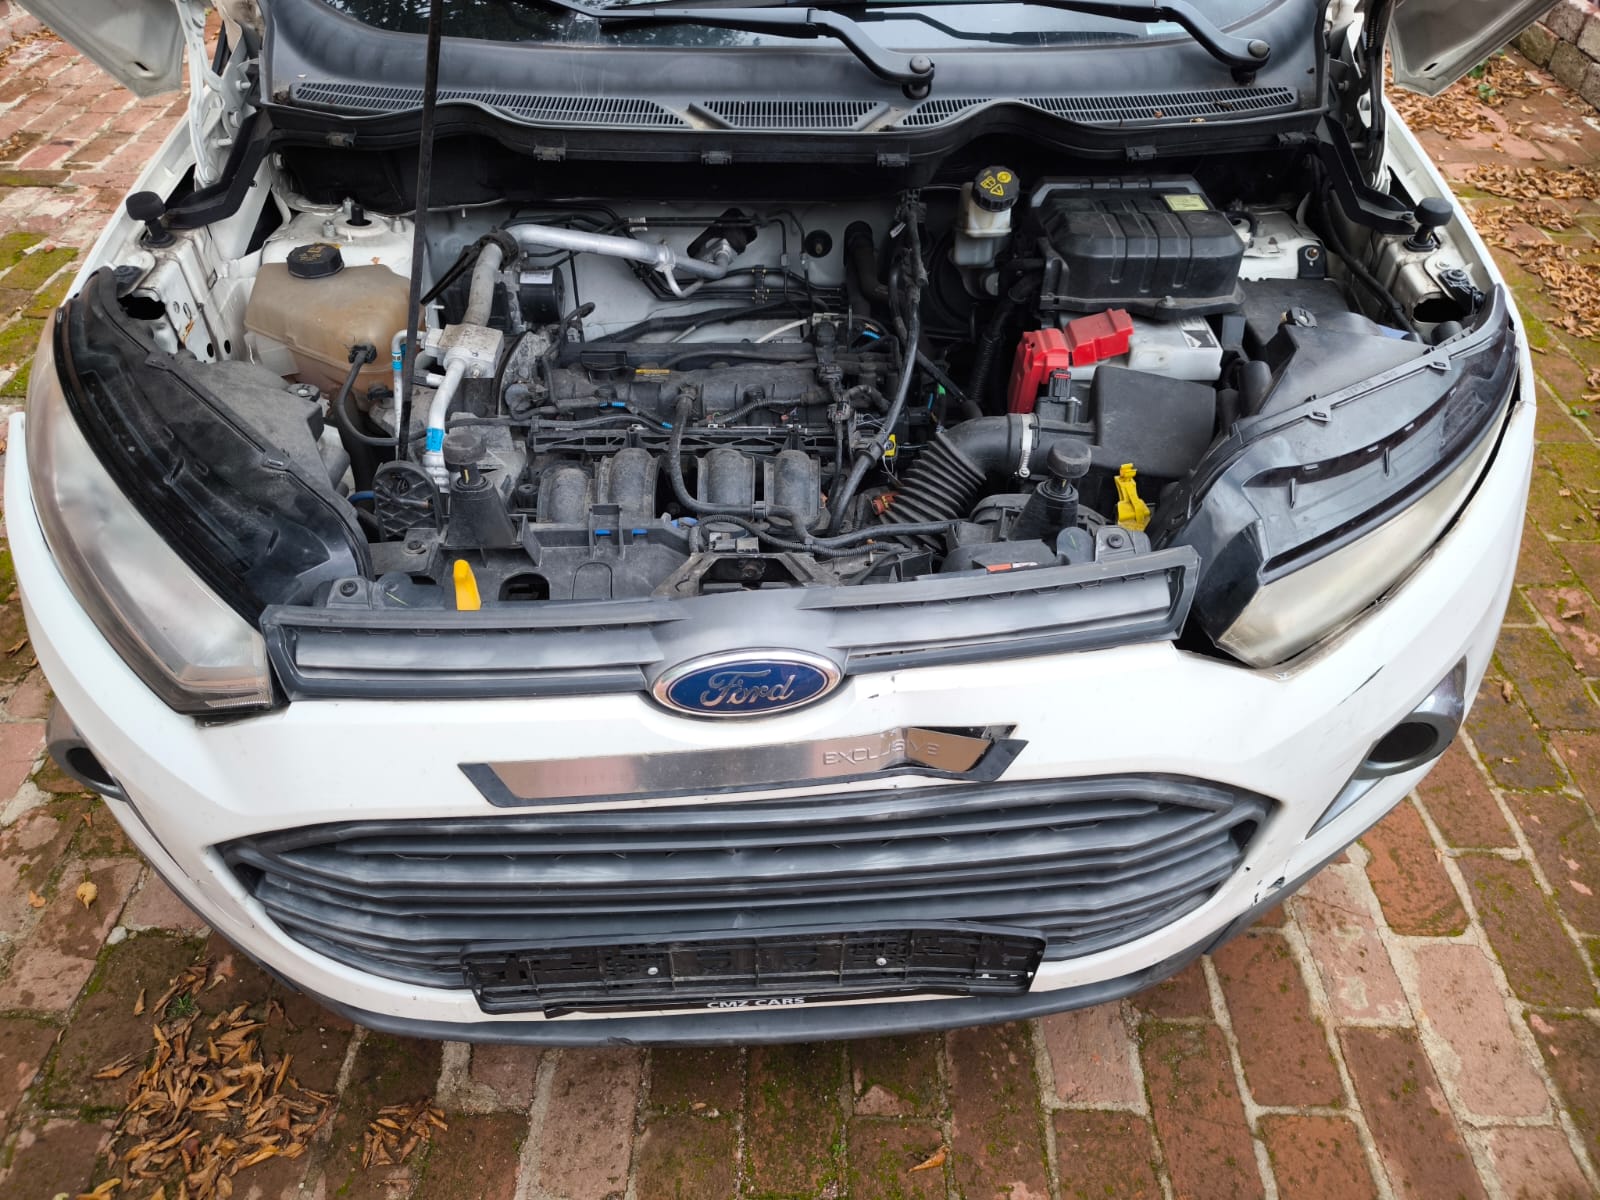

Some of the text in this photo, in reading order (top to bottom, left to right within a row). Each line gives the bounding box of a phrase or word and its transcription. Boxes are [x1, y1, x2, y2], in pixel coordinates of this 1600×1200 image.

[700, 669, 796, 707] Ford
[823, 739, 940, 764] EXCLUSVE
[755, 997, 805, 1006] CARS
